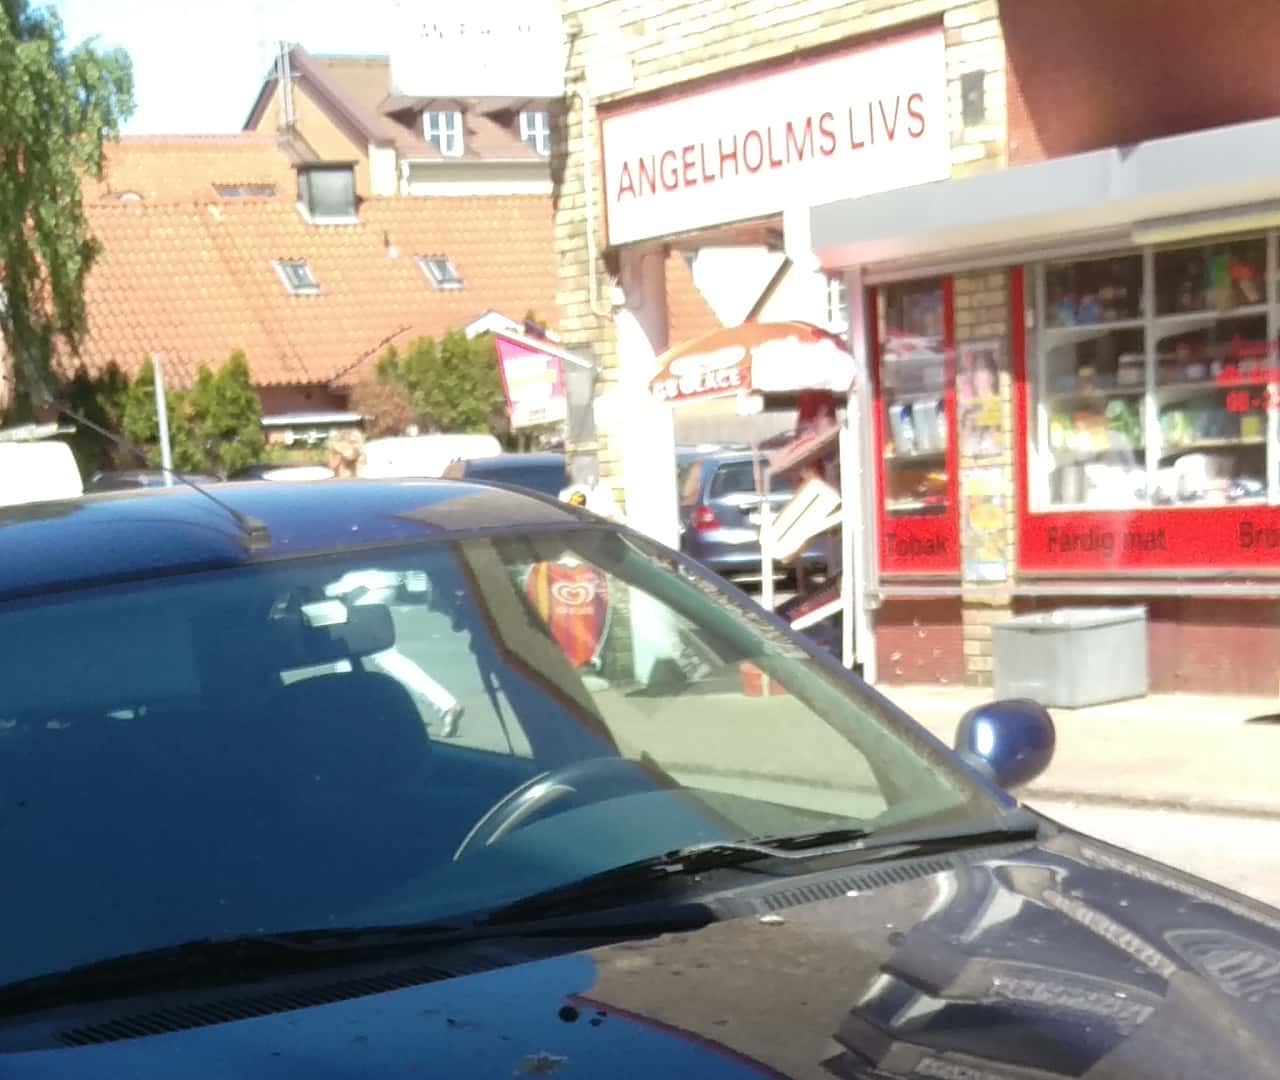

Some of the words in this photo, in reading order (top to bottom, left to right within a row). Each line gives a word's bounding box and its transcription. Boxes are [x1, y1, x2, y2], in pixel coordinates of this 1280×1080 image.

[848, 92, 926, 150] LIVS
[885, 532, 948, 557] Tobak
[1122, 526, 1169, 553] mat
